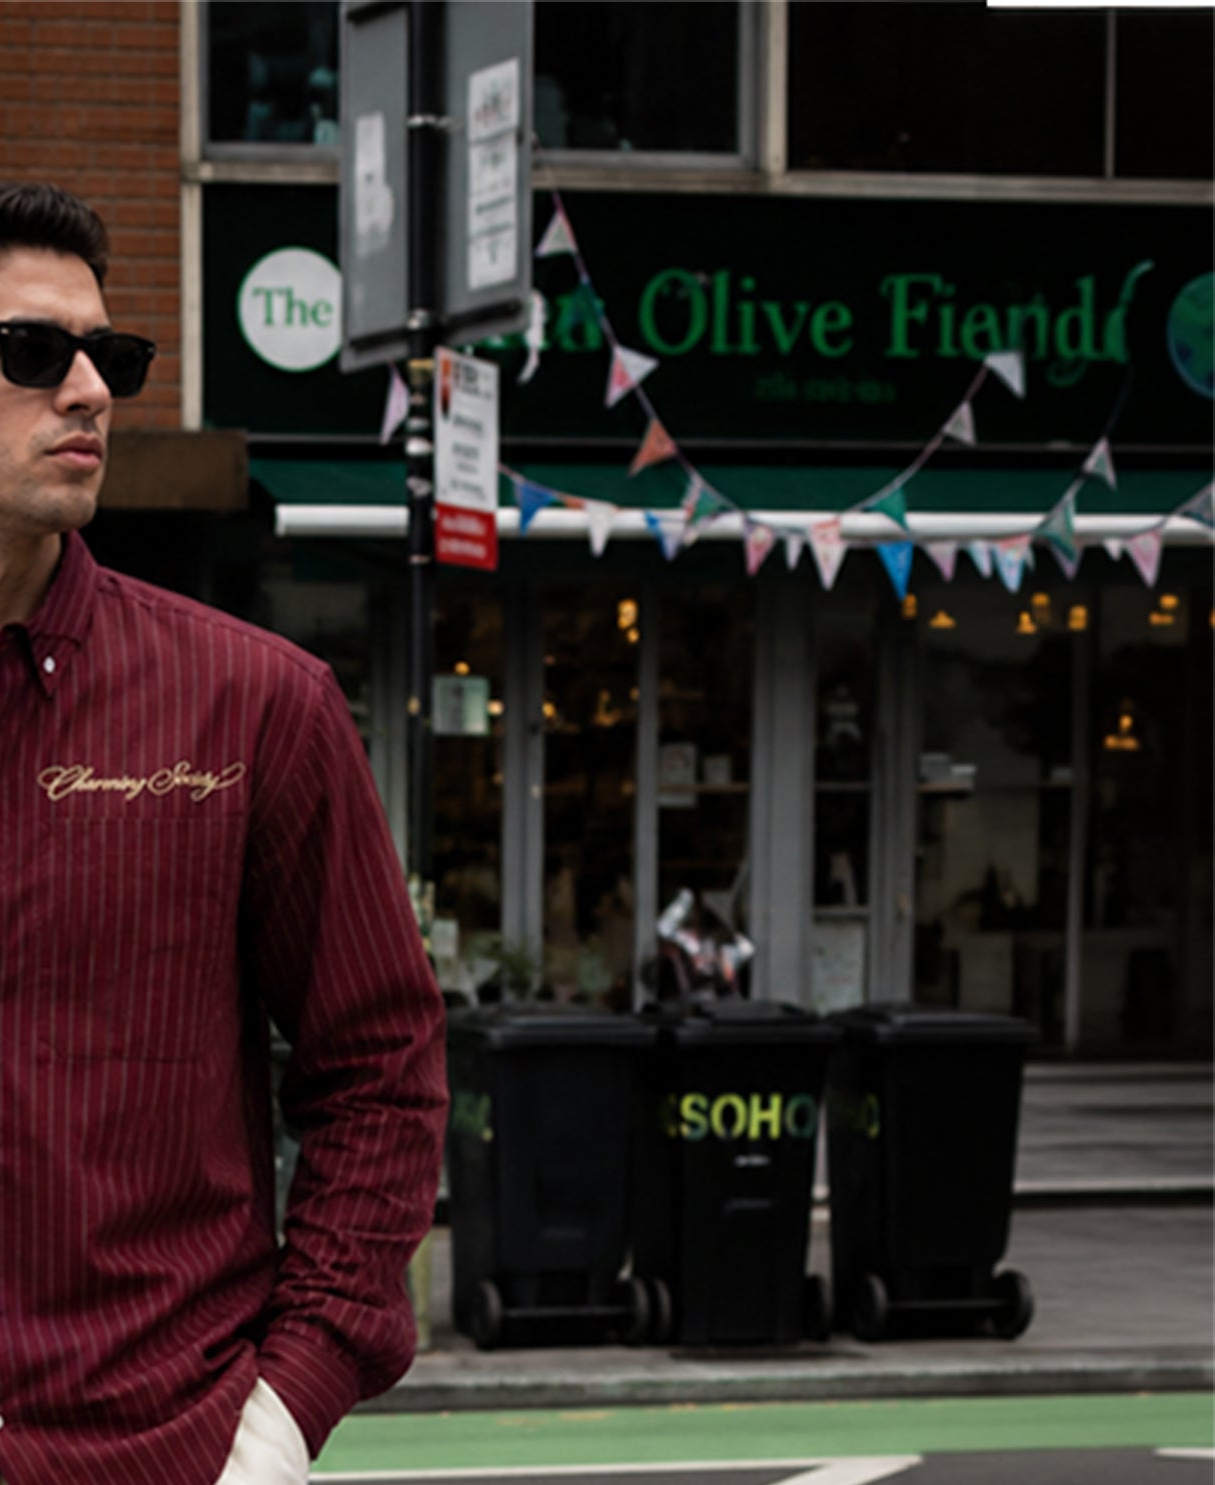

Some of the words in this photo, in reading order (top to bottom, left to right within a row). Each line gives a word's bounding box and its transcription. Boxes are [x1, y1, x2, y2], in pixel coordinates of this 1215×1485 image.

[251, 284, 333, 330] The
[638, 266, 853, 357] Olive
[678, 1091, 818, 1143] SOHO
